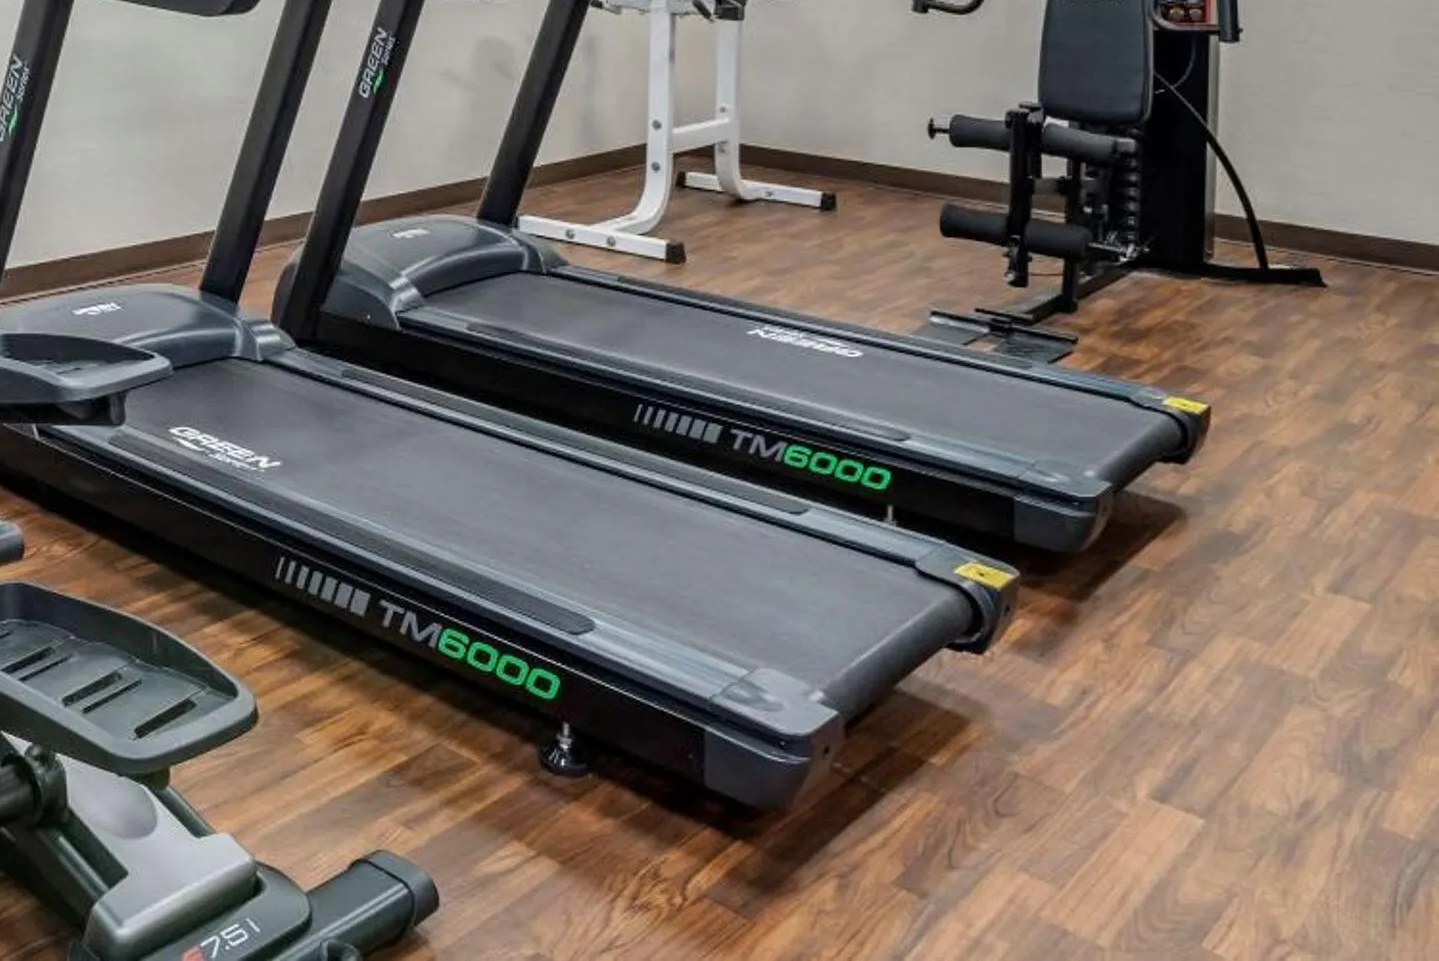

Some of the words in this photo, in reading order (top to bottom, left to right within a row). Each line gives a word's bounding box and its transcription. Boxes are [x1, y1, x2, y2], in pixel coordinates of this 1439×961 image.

[358, 27, 388, 99] GREEN
[730, 428, 892, 490] TM6000
[379, 599, 561, 700] TM6000
